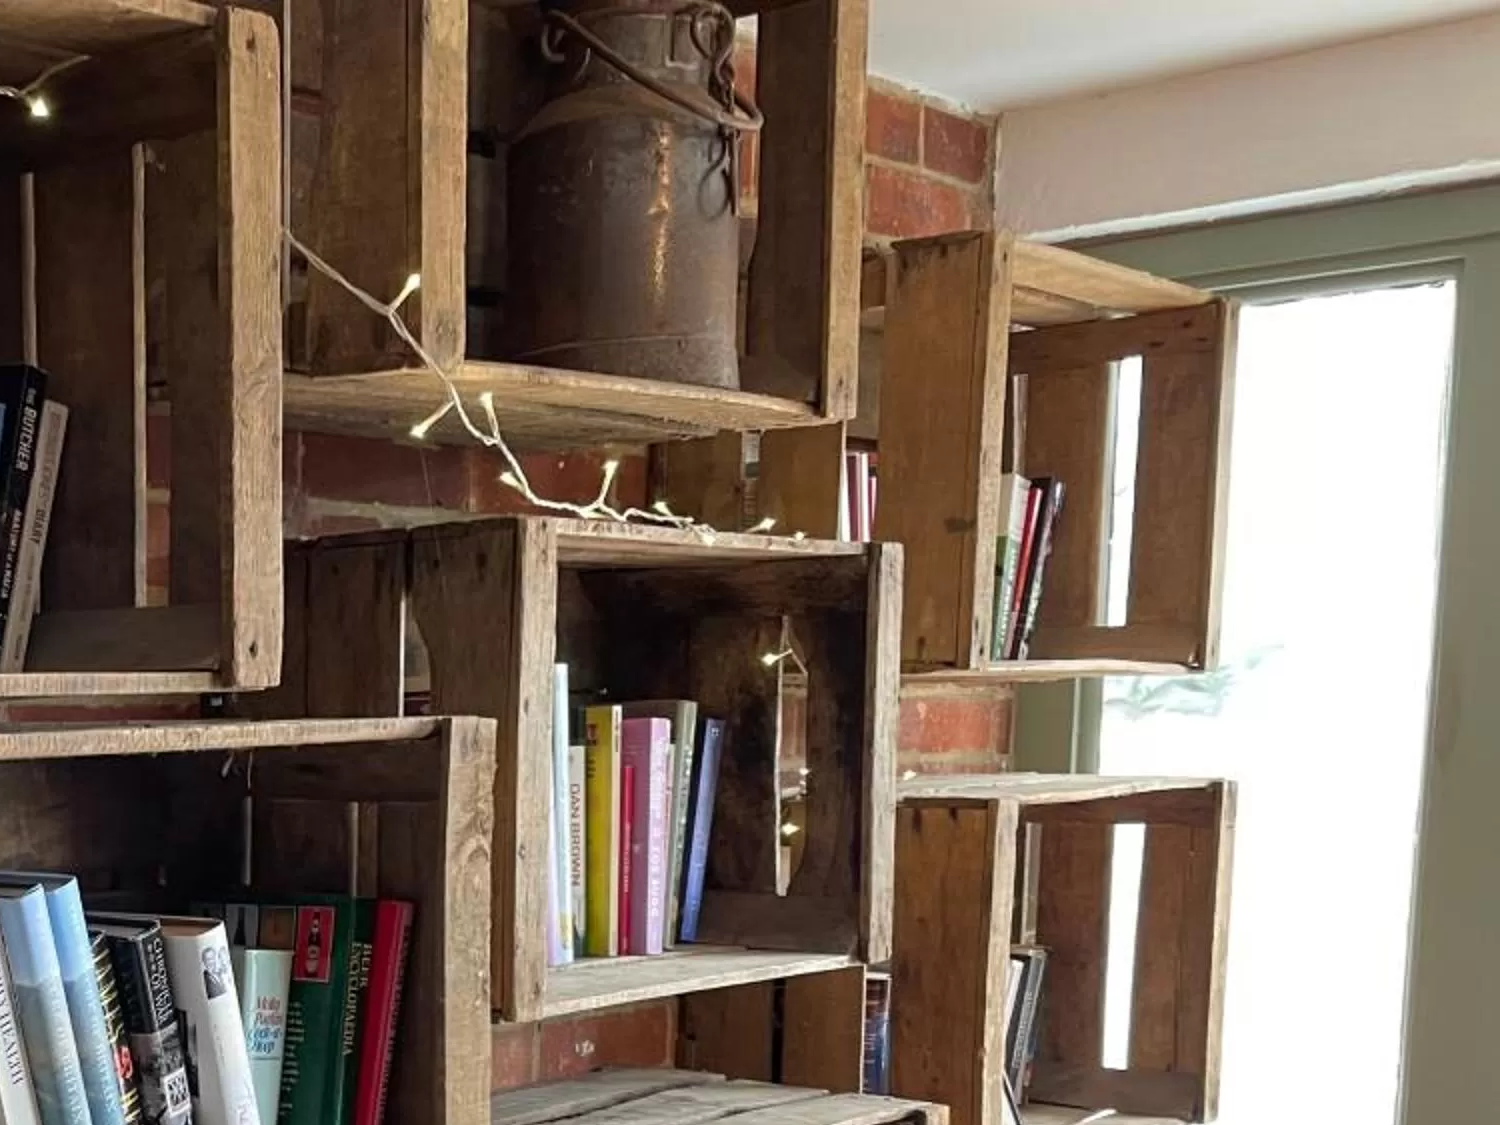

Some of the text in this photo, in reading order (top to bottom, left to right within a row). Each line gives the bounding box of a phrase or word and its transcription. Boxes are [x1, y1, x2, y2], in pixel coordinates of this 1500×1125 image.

[14, 404, 38, 472] BUTCHER
[571, 821, 583, 888] BROWN
[342, 942, 362, 1056] ENCYCLOPAEDIA
[0, 1011, 25, 1086] HEALTH
